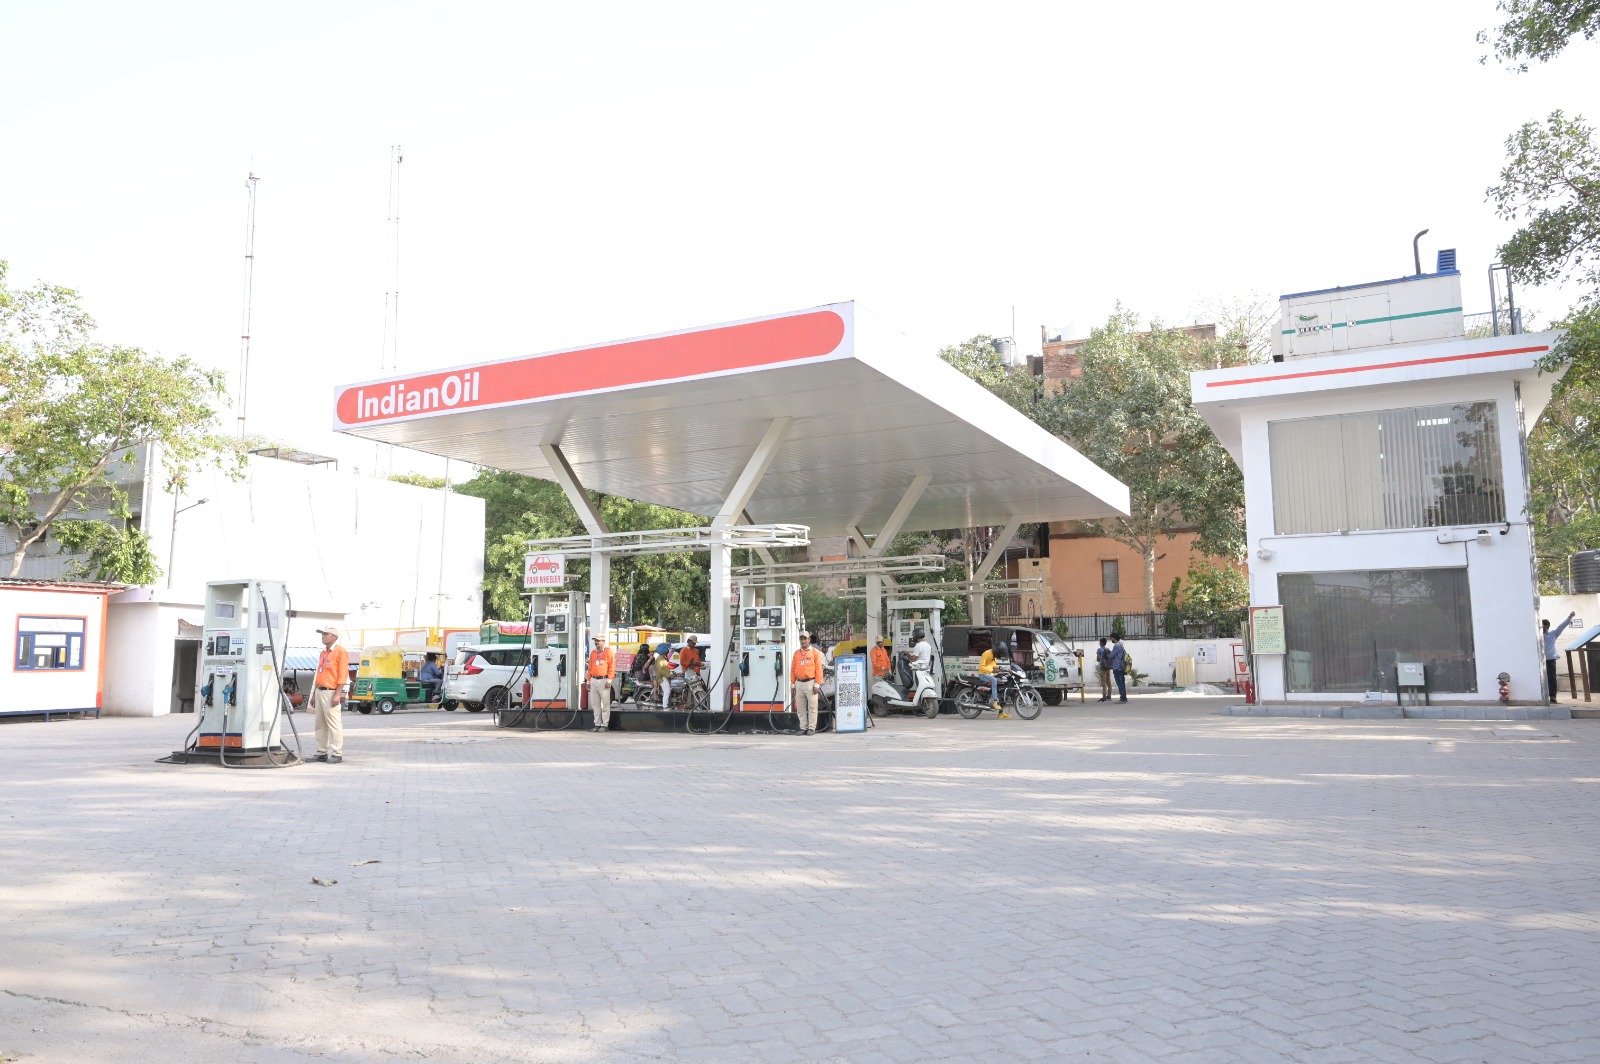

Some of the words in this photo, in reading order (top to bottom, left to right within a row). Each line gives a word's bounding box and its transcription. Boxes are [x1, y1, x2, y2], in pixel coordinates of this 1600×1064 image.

[357, 371, 480, 419] IndianOil
[526, 576, 539, 584] FOUR
[539, 575, 561, 584] WHEELER
